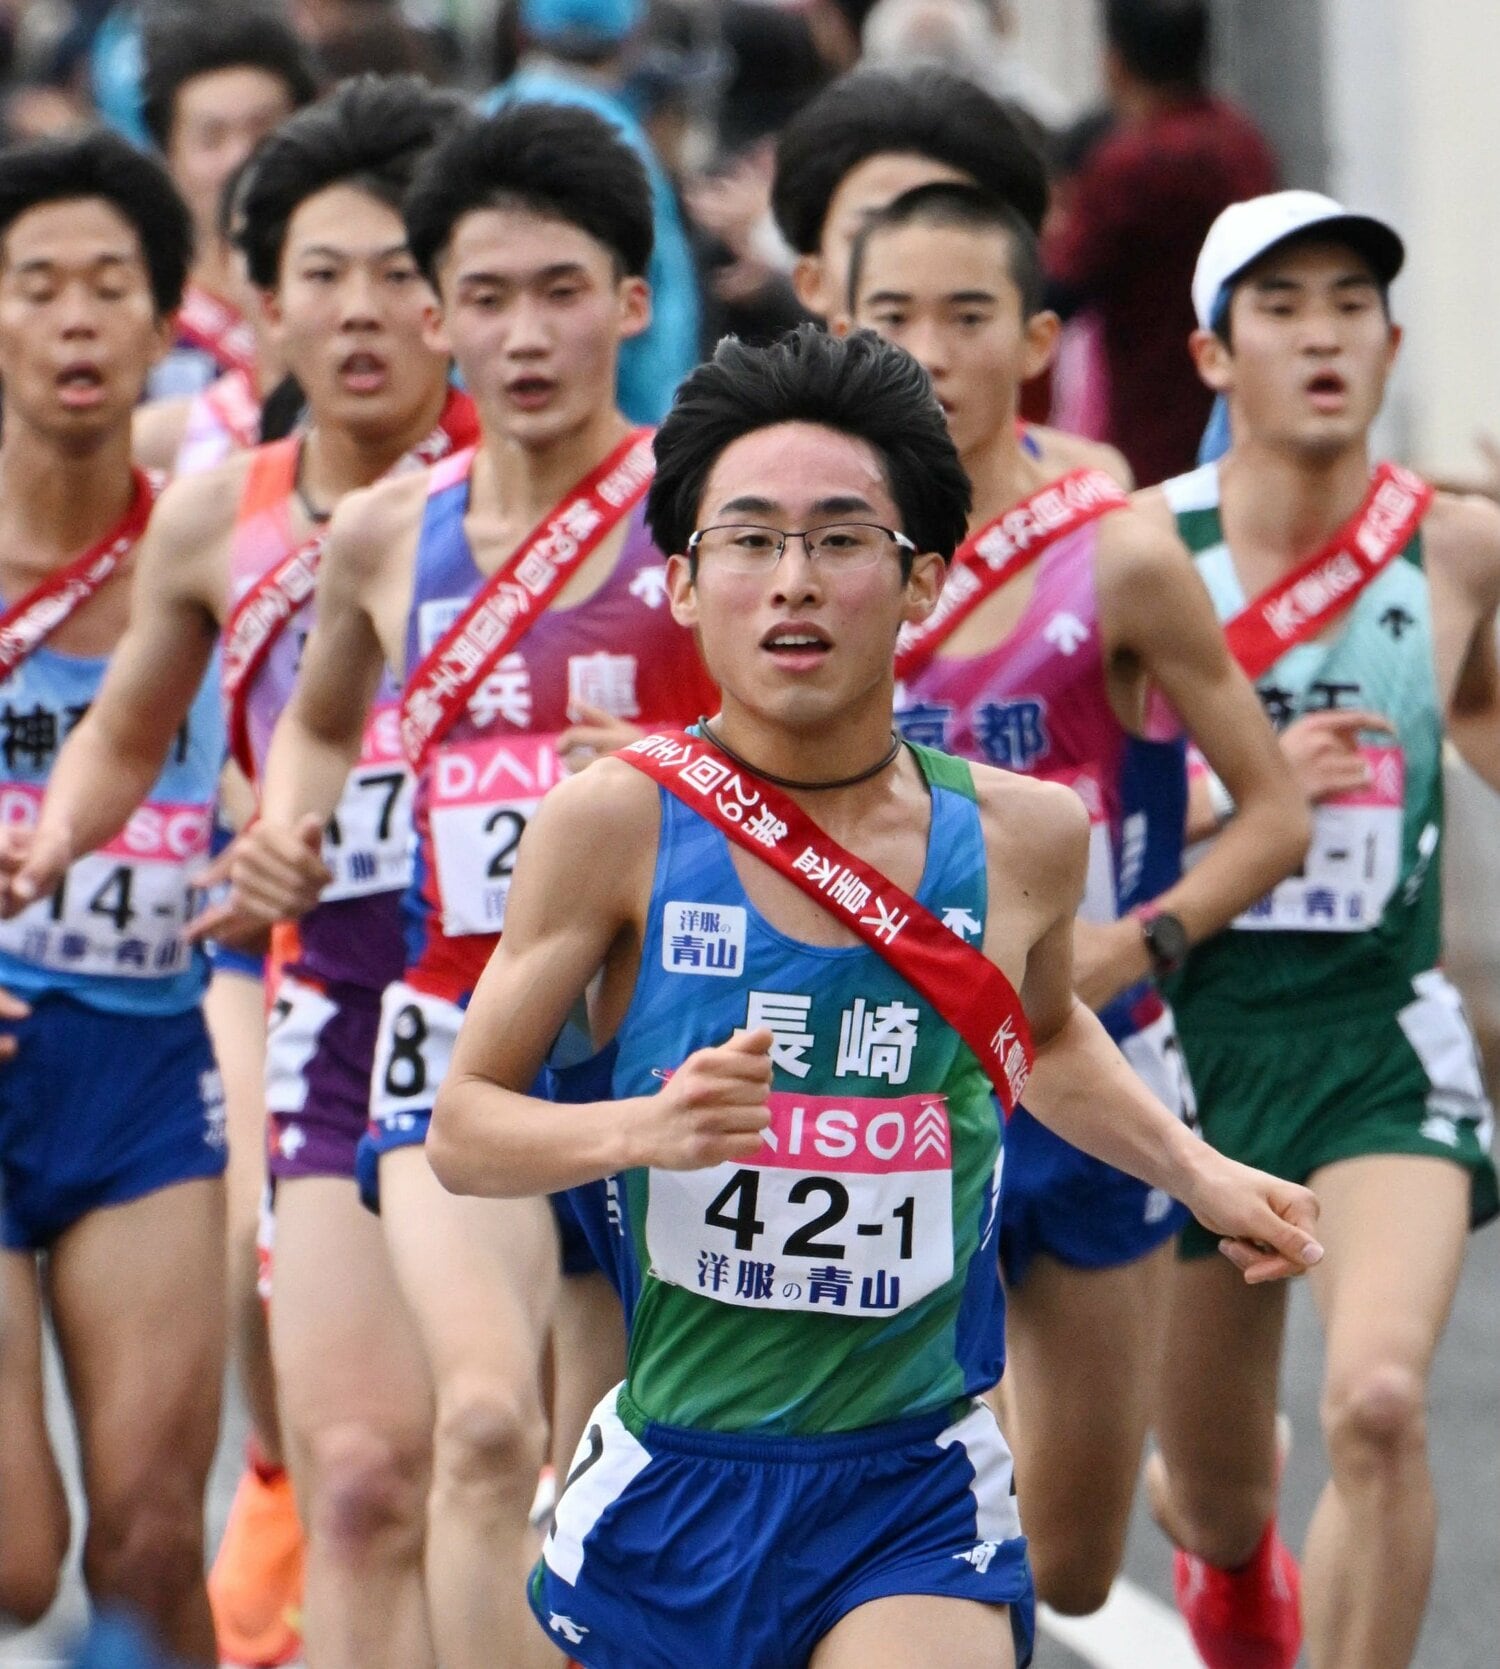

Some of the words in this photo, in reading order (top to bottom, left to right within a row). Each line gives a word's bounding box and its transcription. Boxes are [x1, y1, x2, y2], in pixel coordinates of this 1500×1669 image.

[467, 652, 641, 729] 兵庫
[680, 909, 731, 934] 洋服の
[791, 847, 911, 945] 天皇盃
[670, 935, 738, 970] 青山
[733, 990, 920, 1085] 長崎
[704, 1168, 915, 1261] 42-1
[696, 1250, 901, 1310] 洋服の青山
